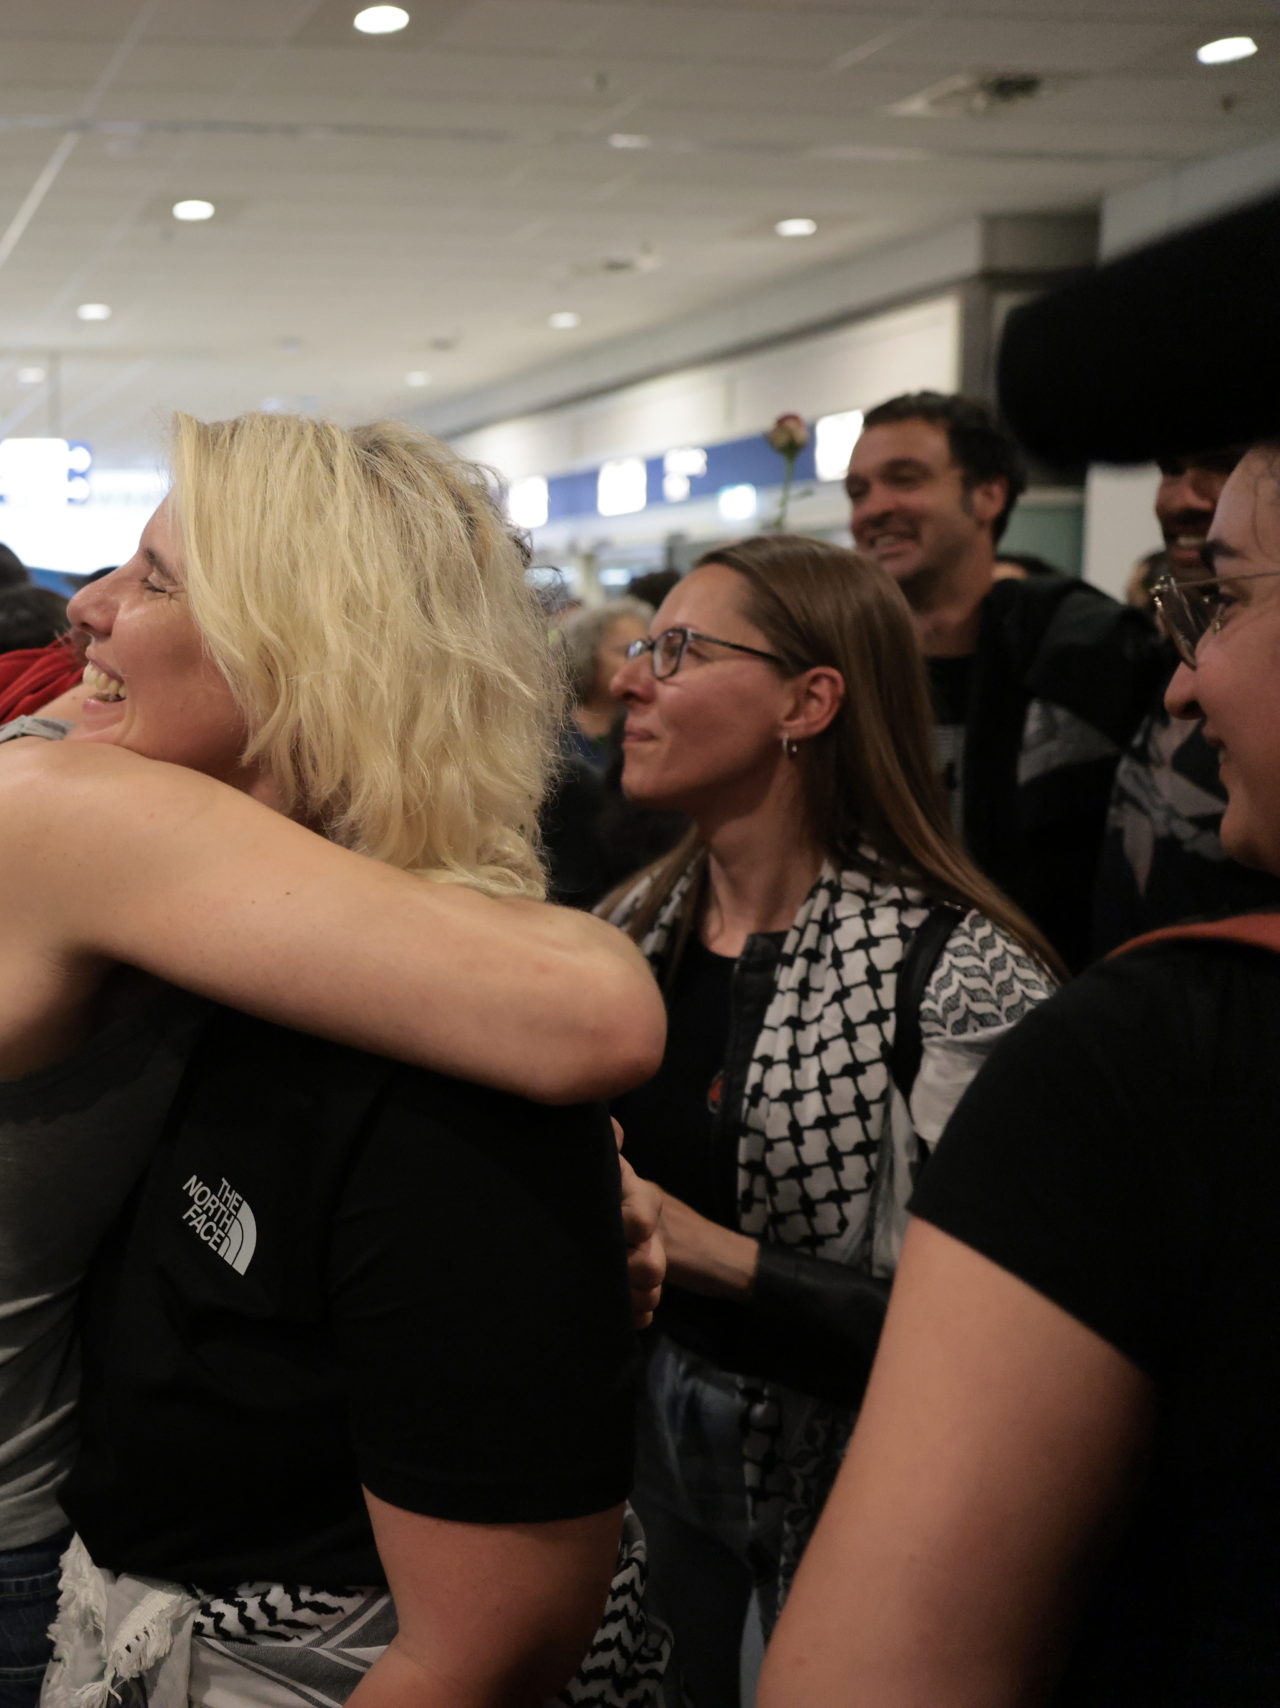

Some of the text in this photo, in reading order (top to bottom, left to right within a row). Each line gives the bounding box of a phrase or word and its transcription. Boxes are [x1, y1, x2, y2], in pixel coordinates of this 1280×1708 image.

[182, 1174, 235, 1233] NORTH
[217, 1177, 243, 1215] THE
[182, 1204, 225, 1251] FACE
